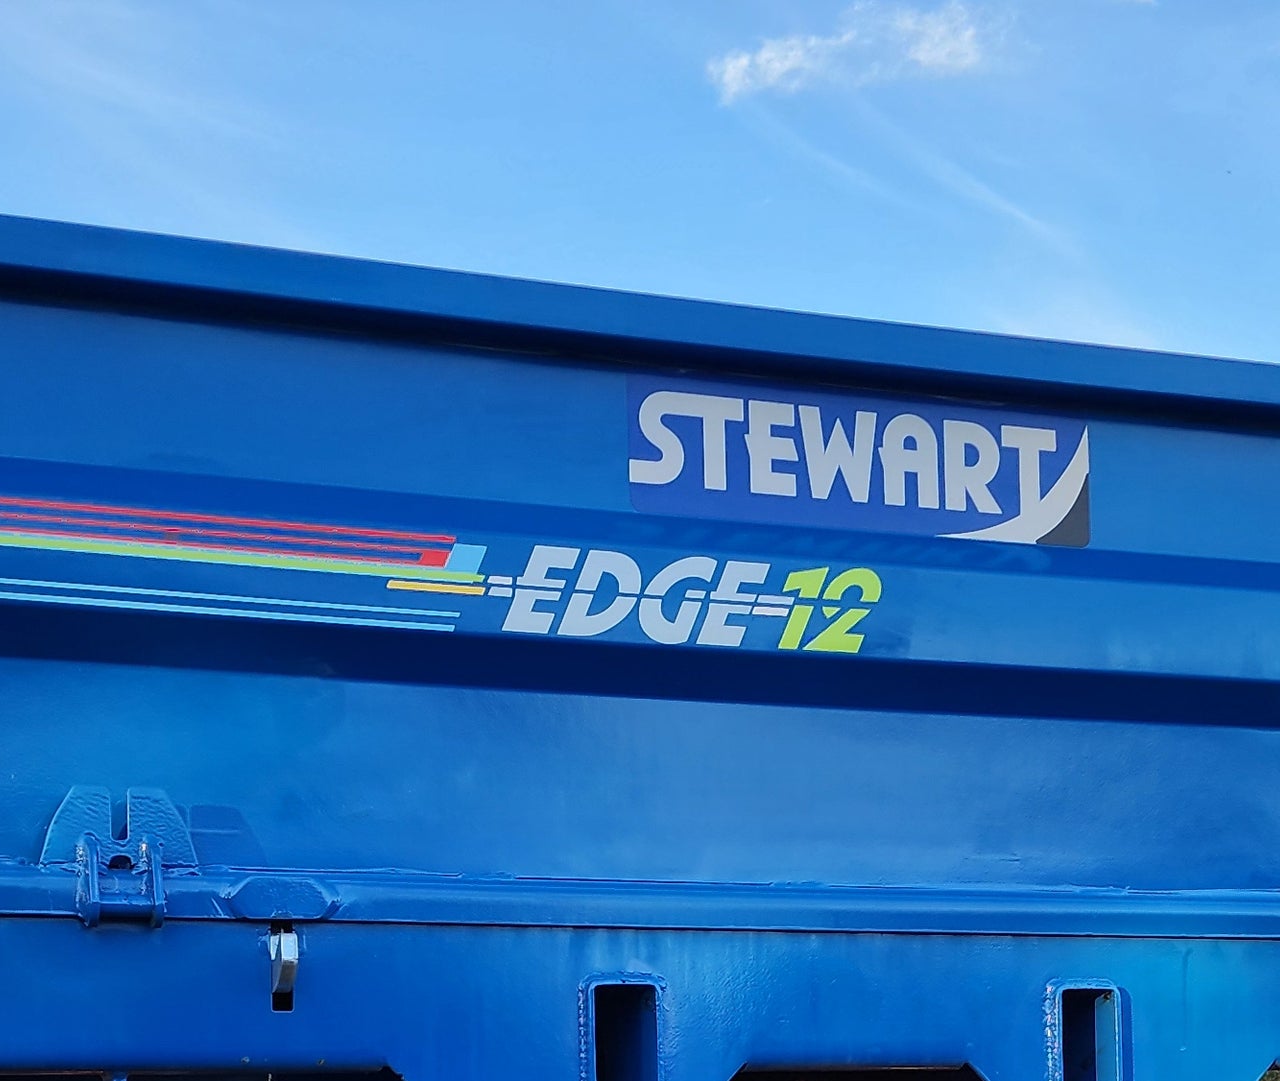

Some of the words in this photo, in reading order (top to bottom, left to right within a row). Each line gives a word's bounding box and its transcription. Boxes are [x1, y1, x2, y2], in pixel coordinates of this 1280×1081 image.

[629, 391, 1089, 544] STEWART
[501, 545, 770, 647] EDGE
[777, 566, 883, 653] 12
